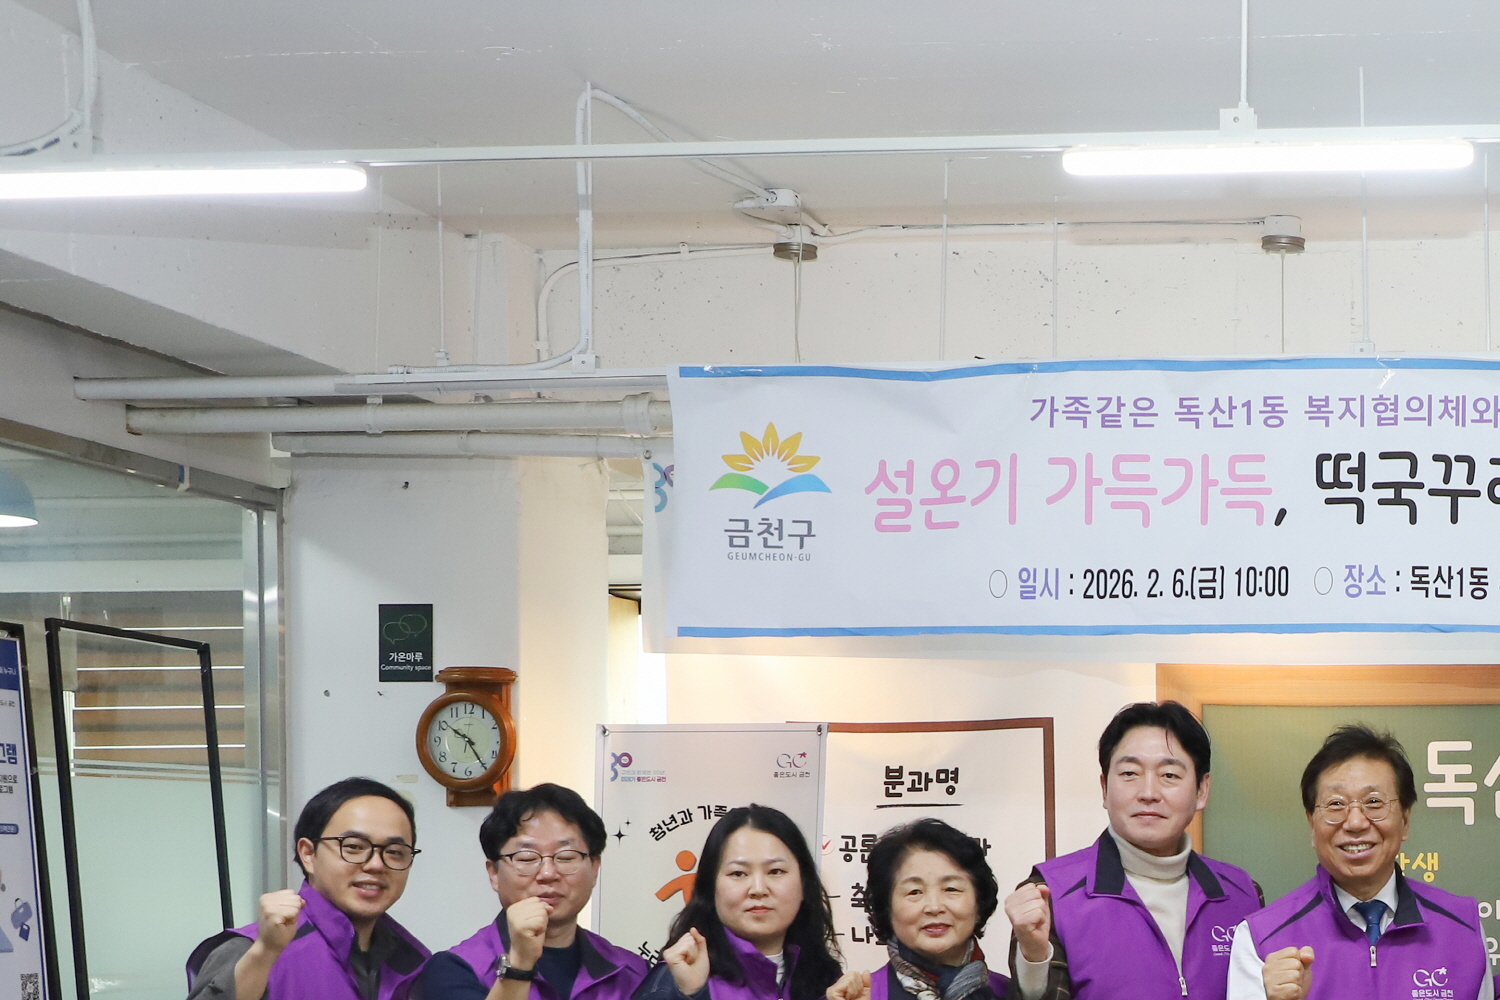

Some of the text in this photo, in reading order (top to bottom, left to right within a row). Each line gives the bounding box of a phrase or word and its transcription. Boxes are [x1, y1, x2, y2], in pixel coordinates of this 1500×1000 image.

[1030, 396, 1158, 428] 가족같은
[1175, 396, 1288, 429] 독산1동
[865, 453, 1017, 532] 설온기
[1046, 453, 1287, 528] 가득가득,
[724, 518, 816, 549] 금천구
[727, 551, 811, 562] GEUMCHEON-GU
[1019, 568, 1059, 600] 일시
[1083, 569, 1137, 599] 2026.
[1235, 566, 1288, 596] 10:00
[1344, 564, 1386, 598] 장소
[1411, 566, 1488, 600] 독산1동
[389, 652, 423, 662] 가온마루
[380, 663, 432, 673] Community space
[463, 703, 475, 715] 12
[433, 735, 441, 747] 9
[438, 751, 447, 763] 8
[451, 762, 457, 773] 7
[464, 767, 472, 777] 6
[884, 765, 960, 796] 분과명
[649, 808, 693, 842] 청년과
[1411, 989, 1454, 998] 좋은도시 금천
